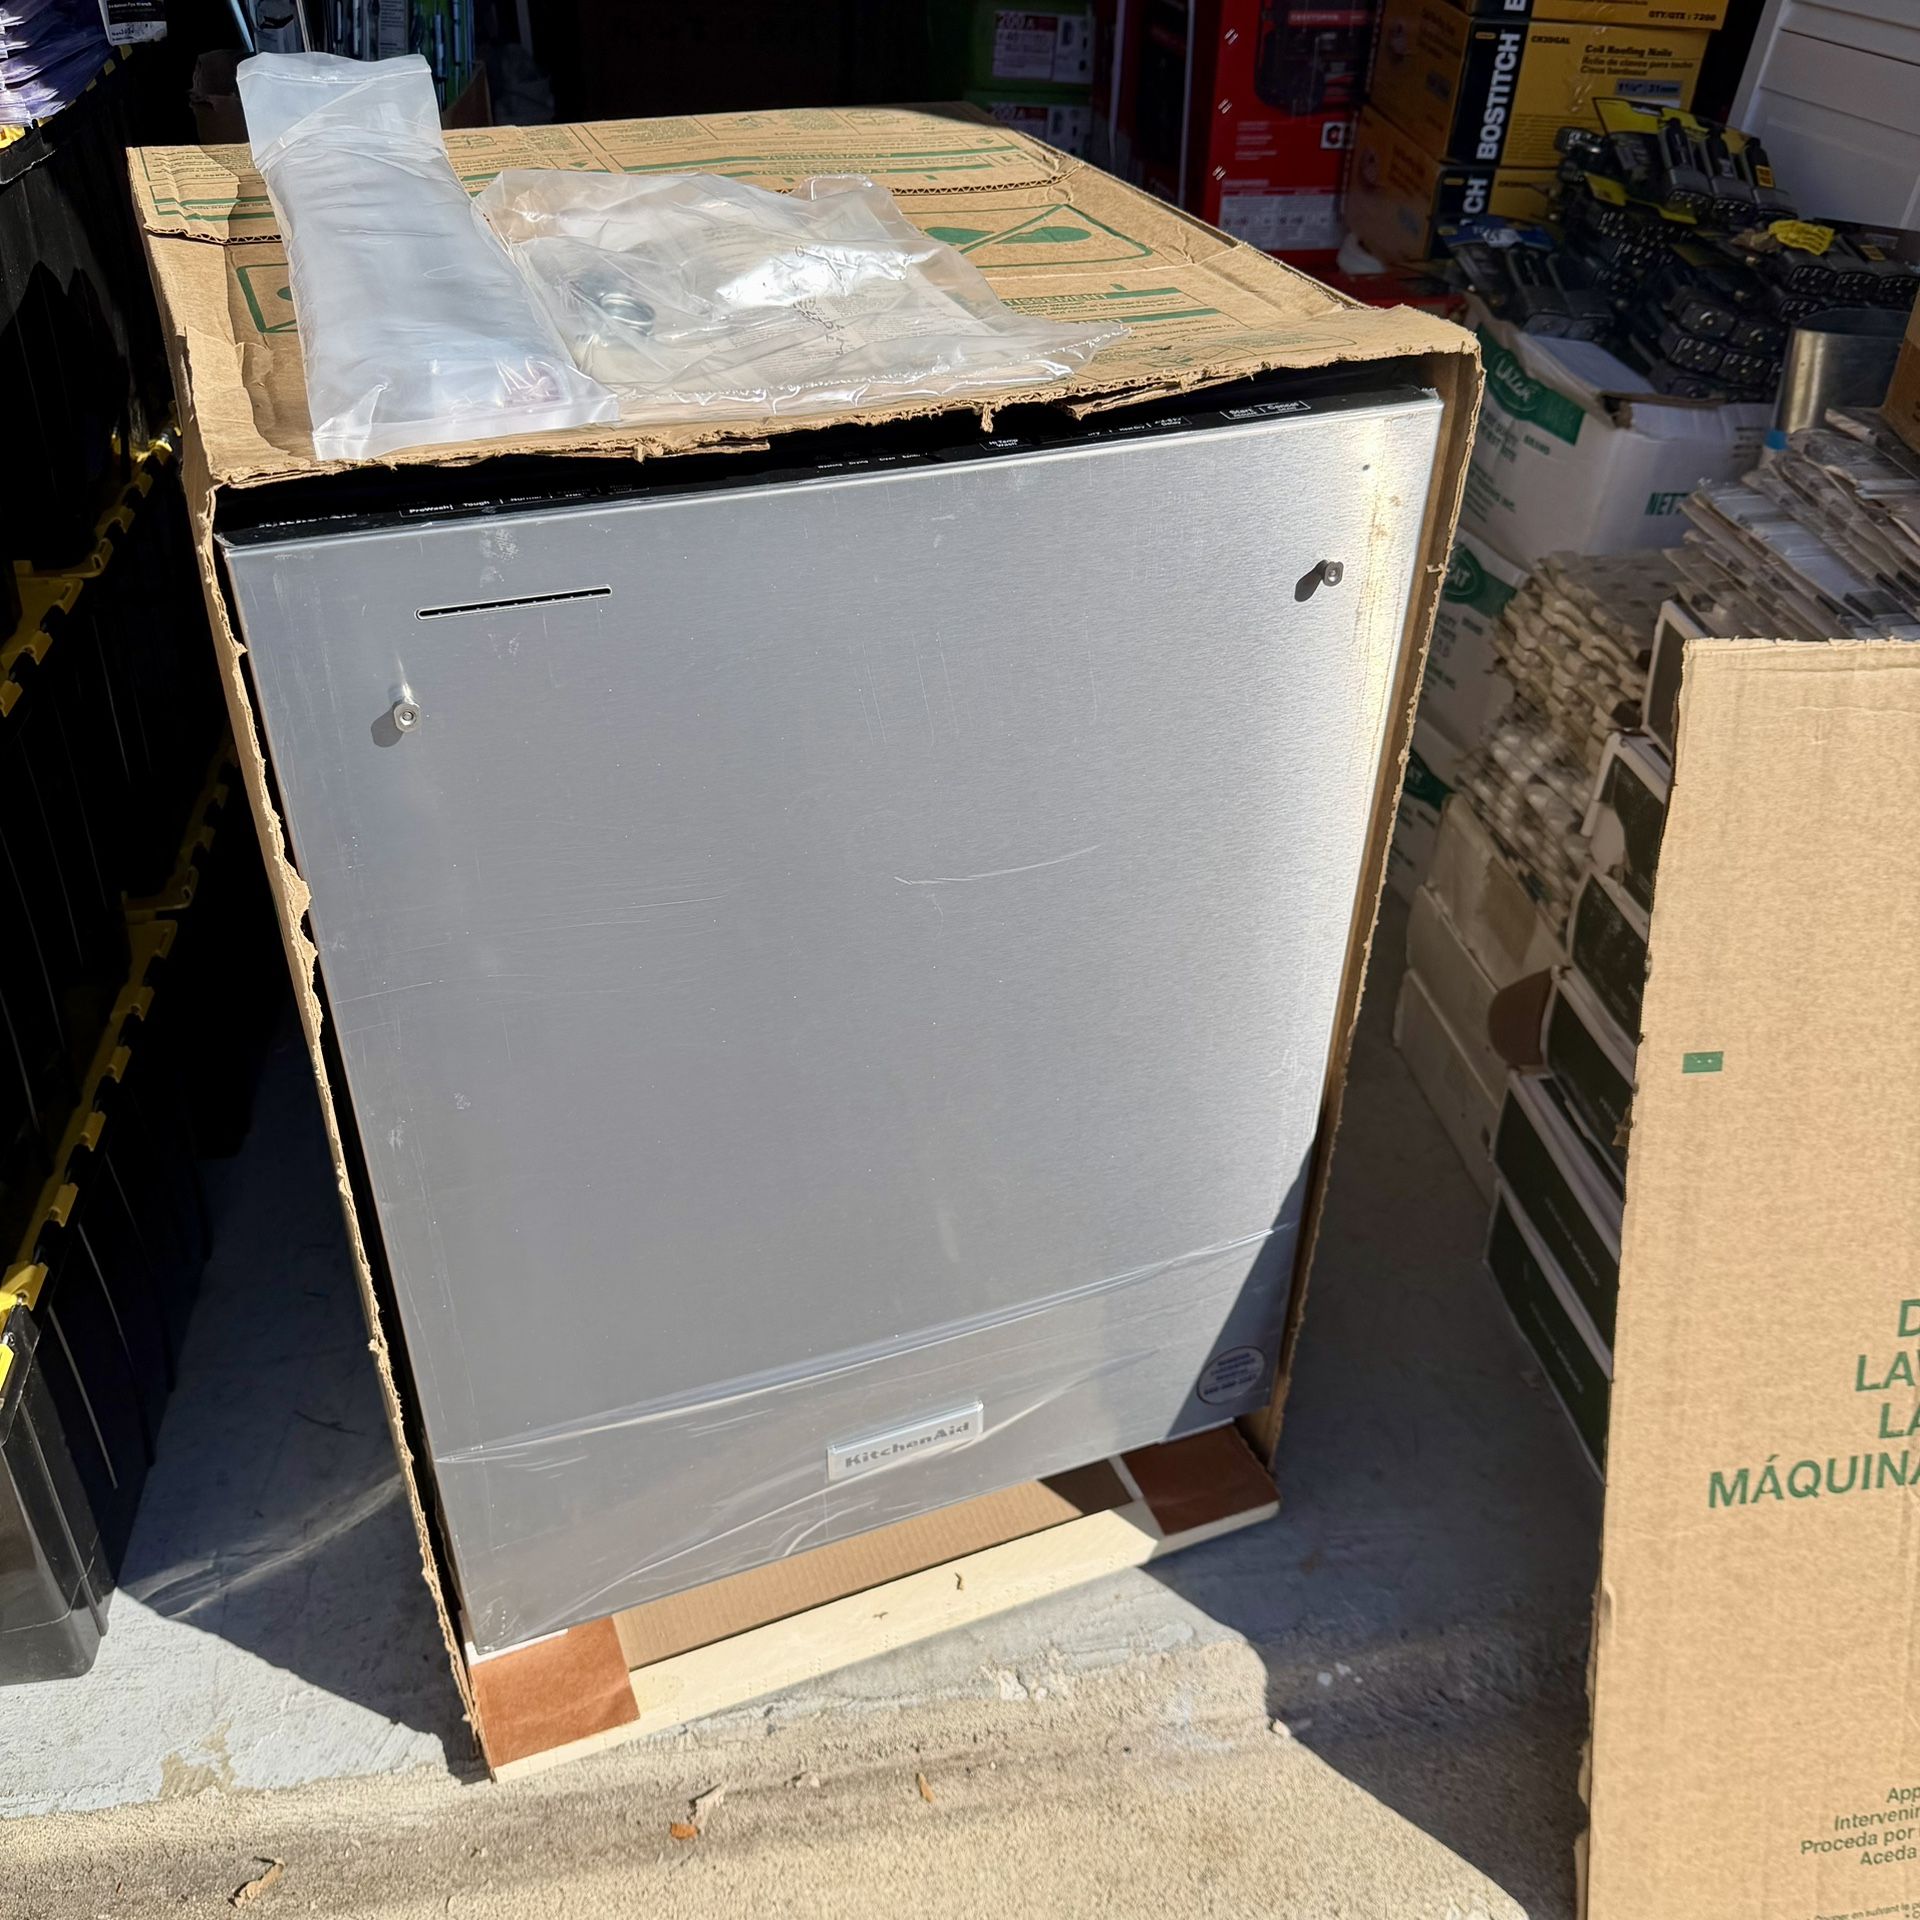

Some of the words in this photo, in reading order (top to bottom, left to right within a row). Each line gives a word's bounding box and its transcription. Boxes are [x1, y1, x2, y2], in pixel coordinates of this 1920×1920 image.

[1693, 13, 1717, 22] 7200
[1585, 44, 1605, 54] Coil
[1607, 45, 1645, 58] Roofing
[1647, 48, 1673, 58] Nails
[1475, 32, 1522, 160] BOSTITCH
[1002, 293, 1109, 308] TISSEMENT
[1855, 1349, 1920, 1392] LA
[845, 1421, 970, 1468] KitchenAid
[1800, 1831, 1878, 1855] Proceda
[1884, 1826, 1916, 1846] por
[1859, 1844, 1918, 1866] Aceda
